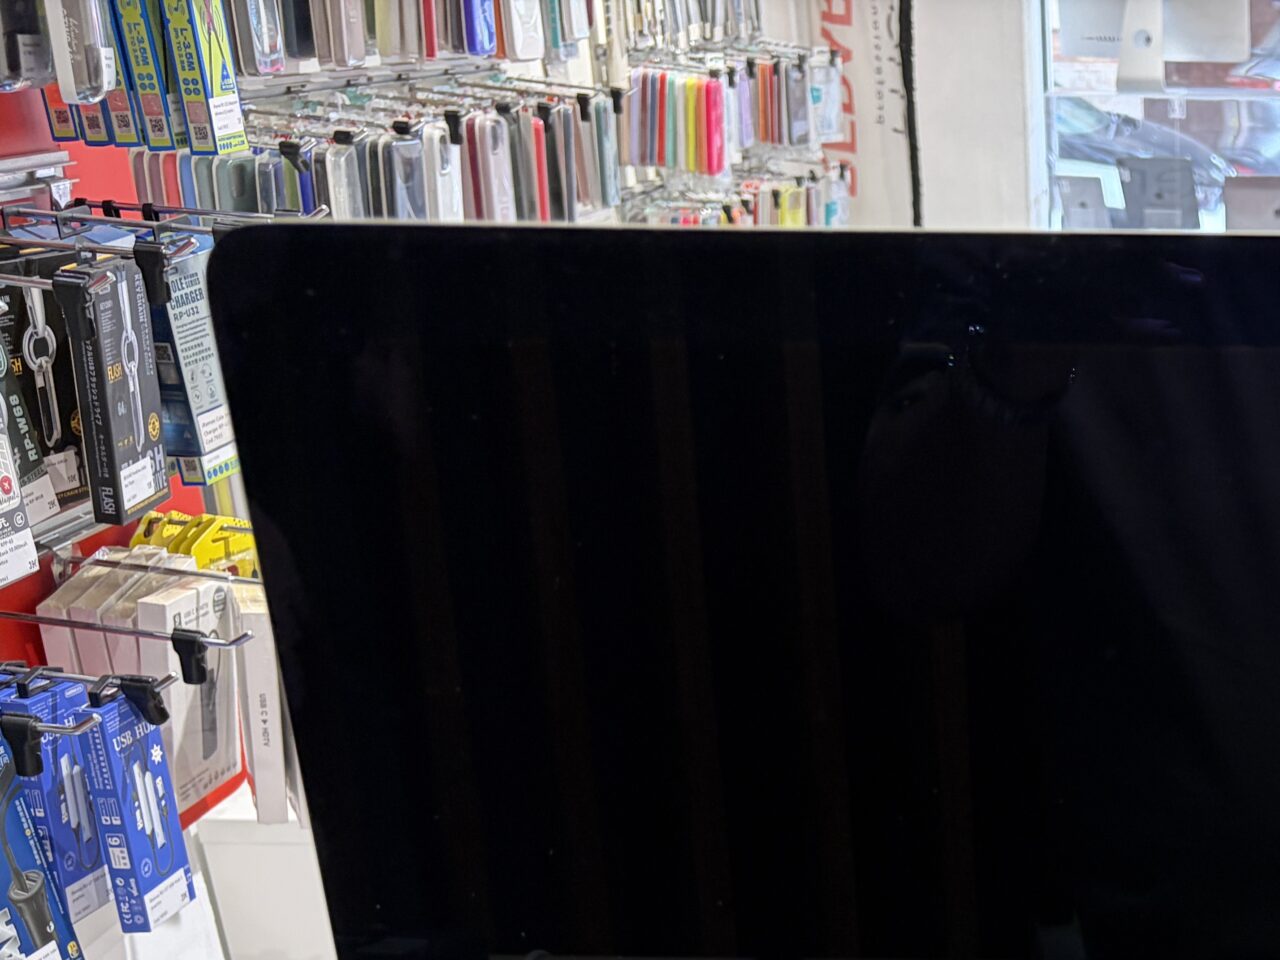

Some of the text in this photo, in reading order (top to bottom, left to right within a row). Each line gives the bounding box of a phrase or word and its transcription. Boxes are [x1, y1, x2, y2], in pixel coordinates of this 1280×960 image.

[9, 394, 39, 462] RP-W68
[101, 486, 116, 515] FLASH
[112, 729, 133, 752] USB
